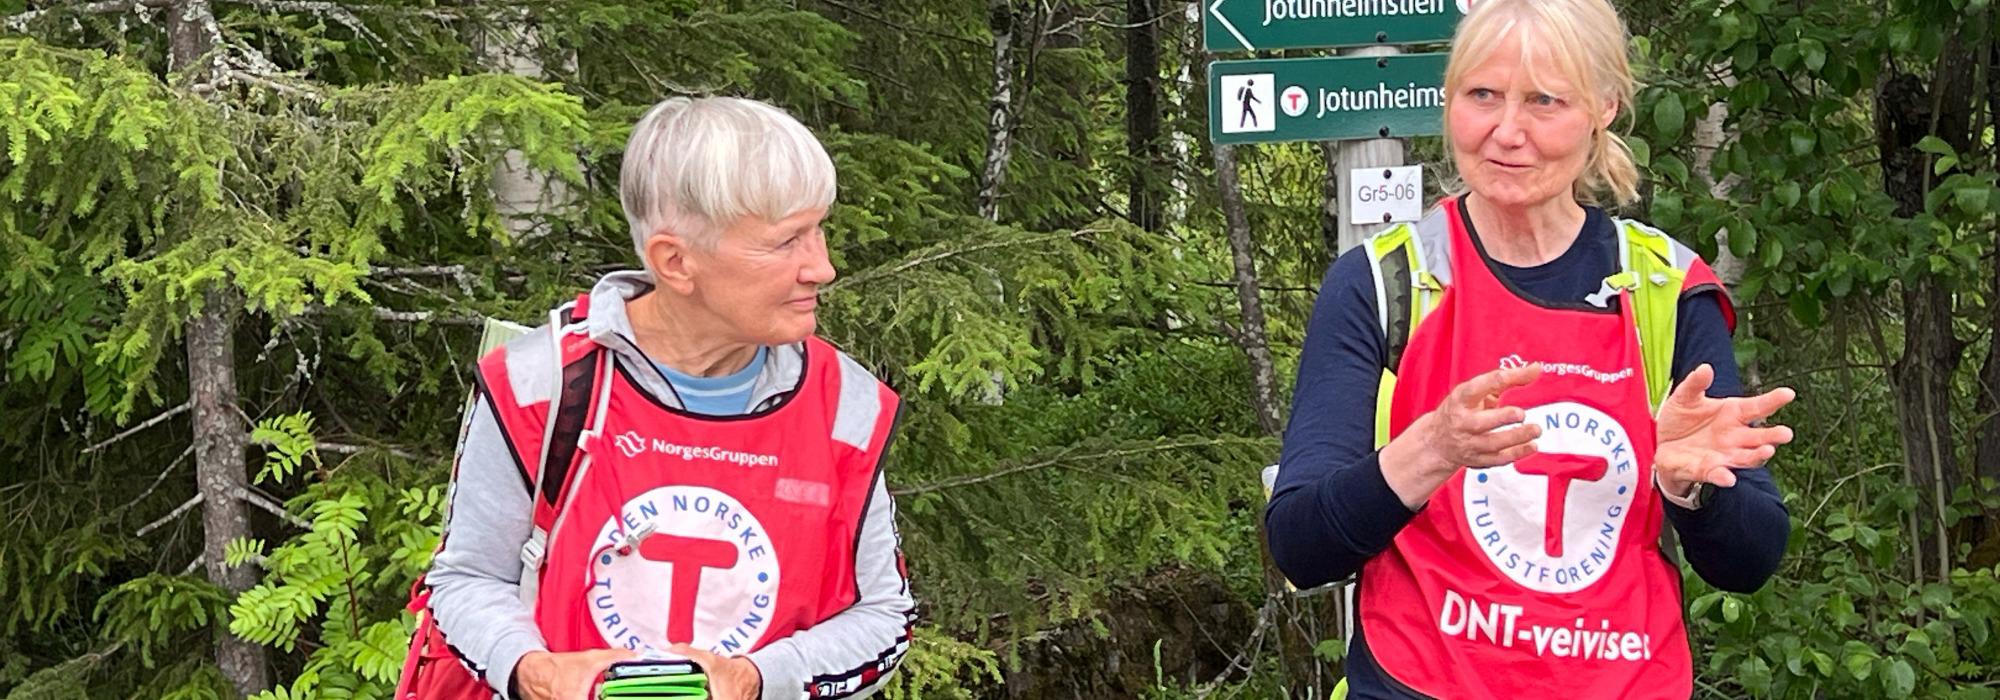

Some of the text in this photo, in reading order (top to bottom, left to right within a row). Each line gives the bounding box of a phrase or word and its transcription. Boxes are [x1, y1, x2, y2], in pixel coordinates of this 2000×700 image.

[1263, 0, 1444, 26] Jotunheimstien
[1287, 94, 1302, 110] T
[1358, 183, 1415, 202] Gr5-06
[652, 439, 779, 467] NorgesGruppen
[1546, 412, 1631, 476] NORSKE
[673, 495, 766, 560] NORSKE
[1513, 453, 1608, 557] T
[1472, 496, 1622, 585] TURISTFORENING
[640, 532, 738, 643] T
